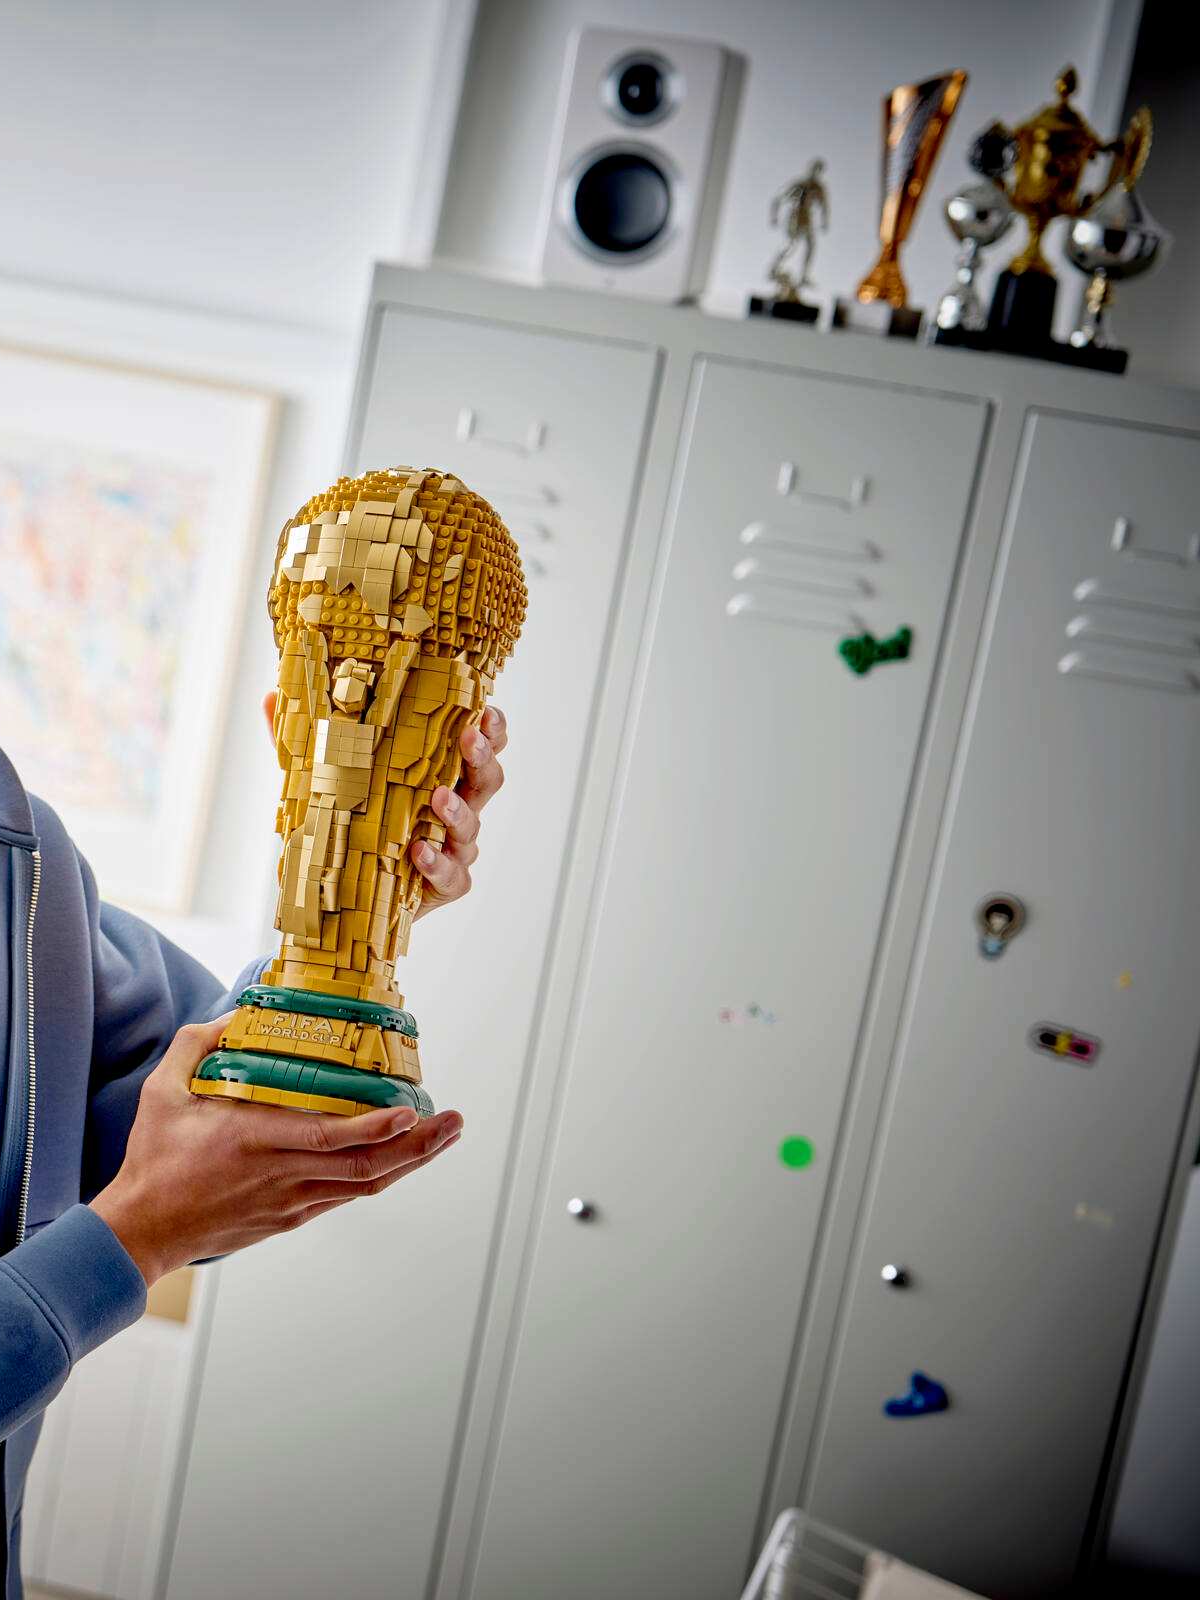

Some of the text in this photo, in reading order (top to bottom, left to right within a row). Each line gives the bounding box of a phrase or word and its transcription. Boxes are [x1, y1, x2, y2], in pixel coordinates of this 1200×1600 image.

[272, 1012, 334, 1034] FIFA
[260, 1024, 342, 1046] WORLD CUP
